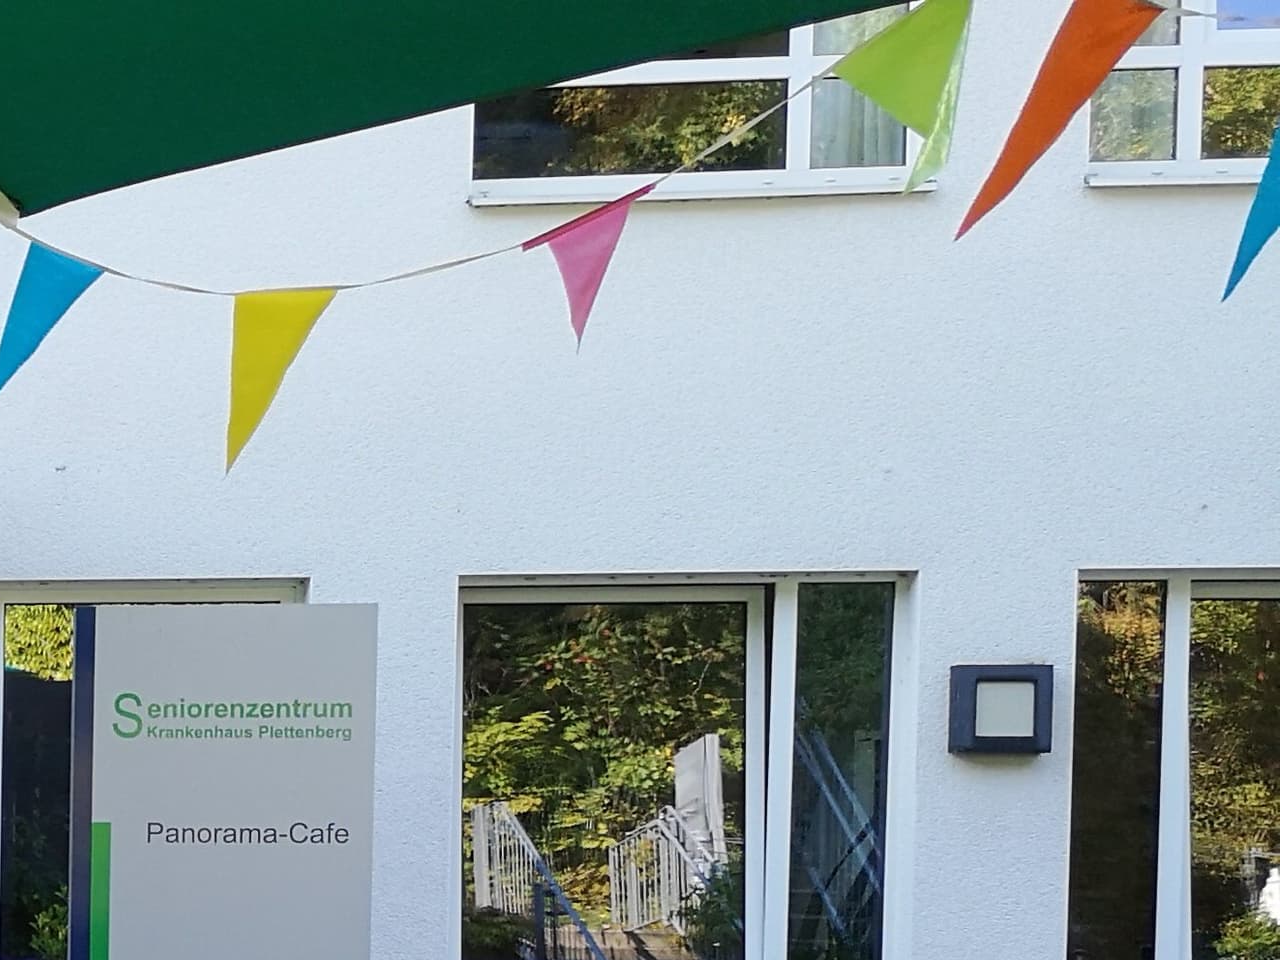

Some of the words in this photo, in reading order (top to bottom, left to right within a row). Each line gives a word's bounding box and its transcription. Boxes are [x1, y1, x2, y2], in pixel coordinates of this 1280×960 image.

[112, 692, 353, 739] Seniorenzentrum
[147, 726, 253, 739] Krankenhaus
[258, 725, 353, 741] Plettenberg
[146, 822, 350, 844] Panorama-Cafe
